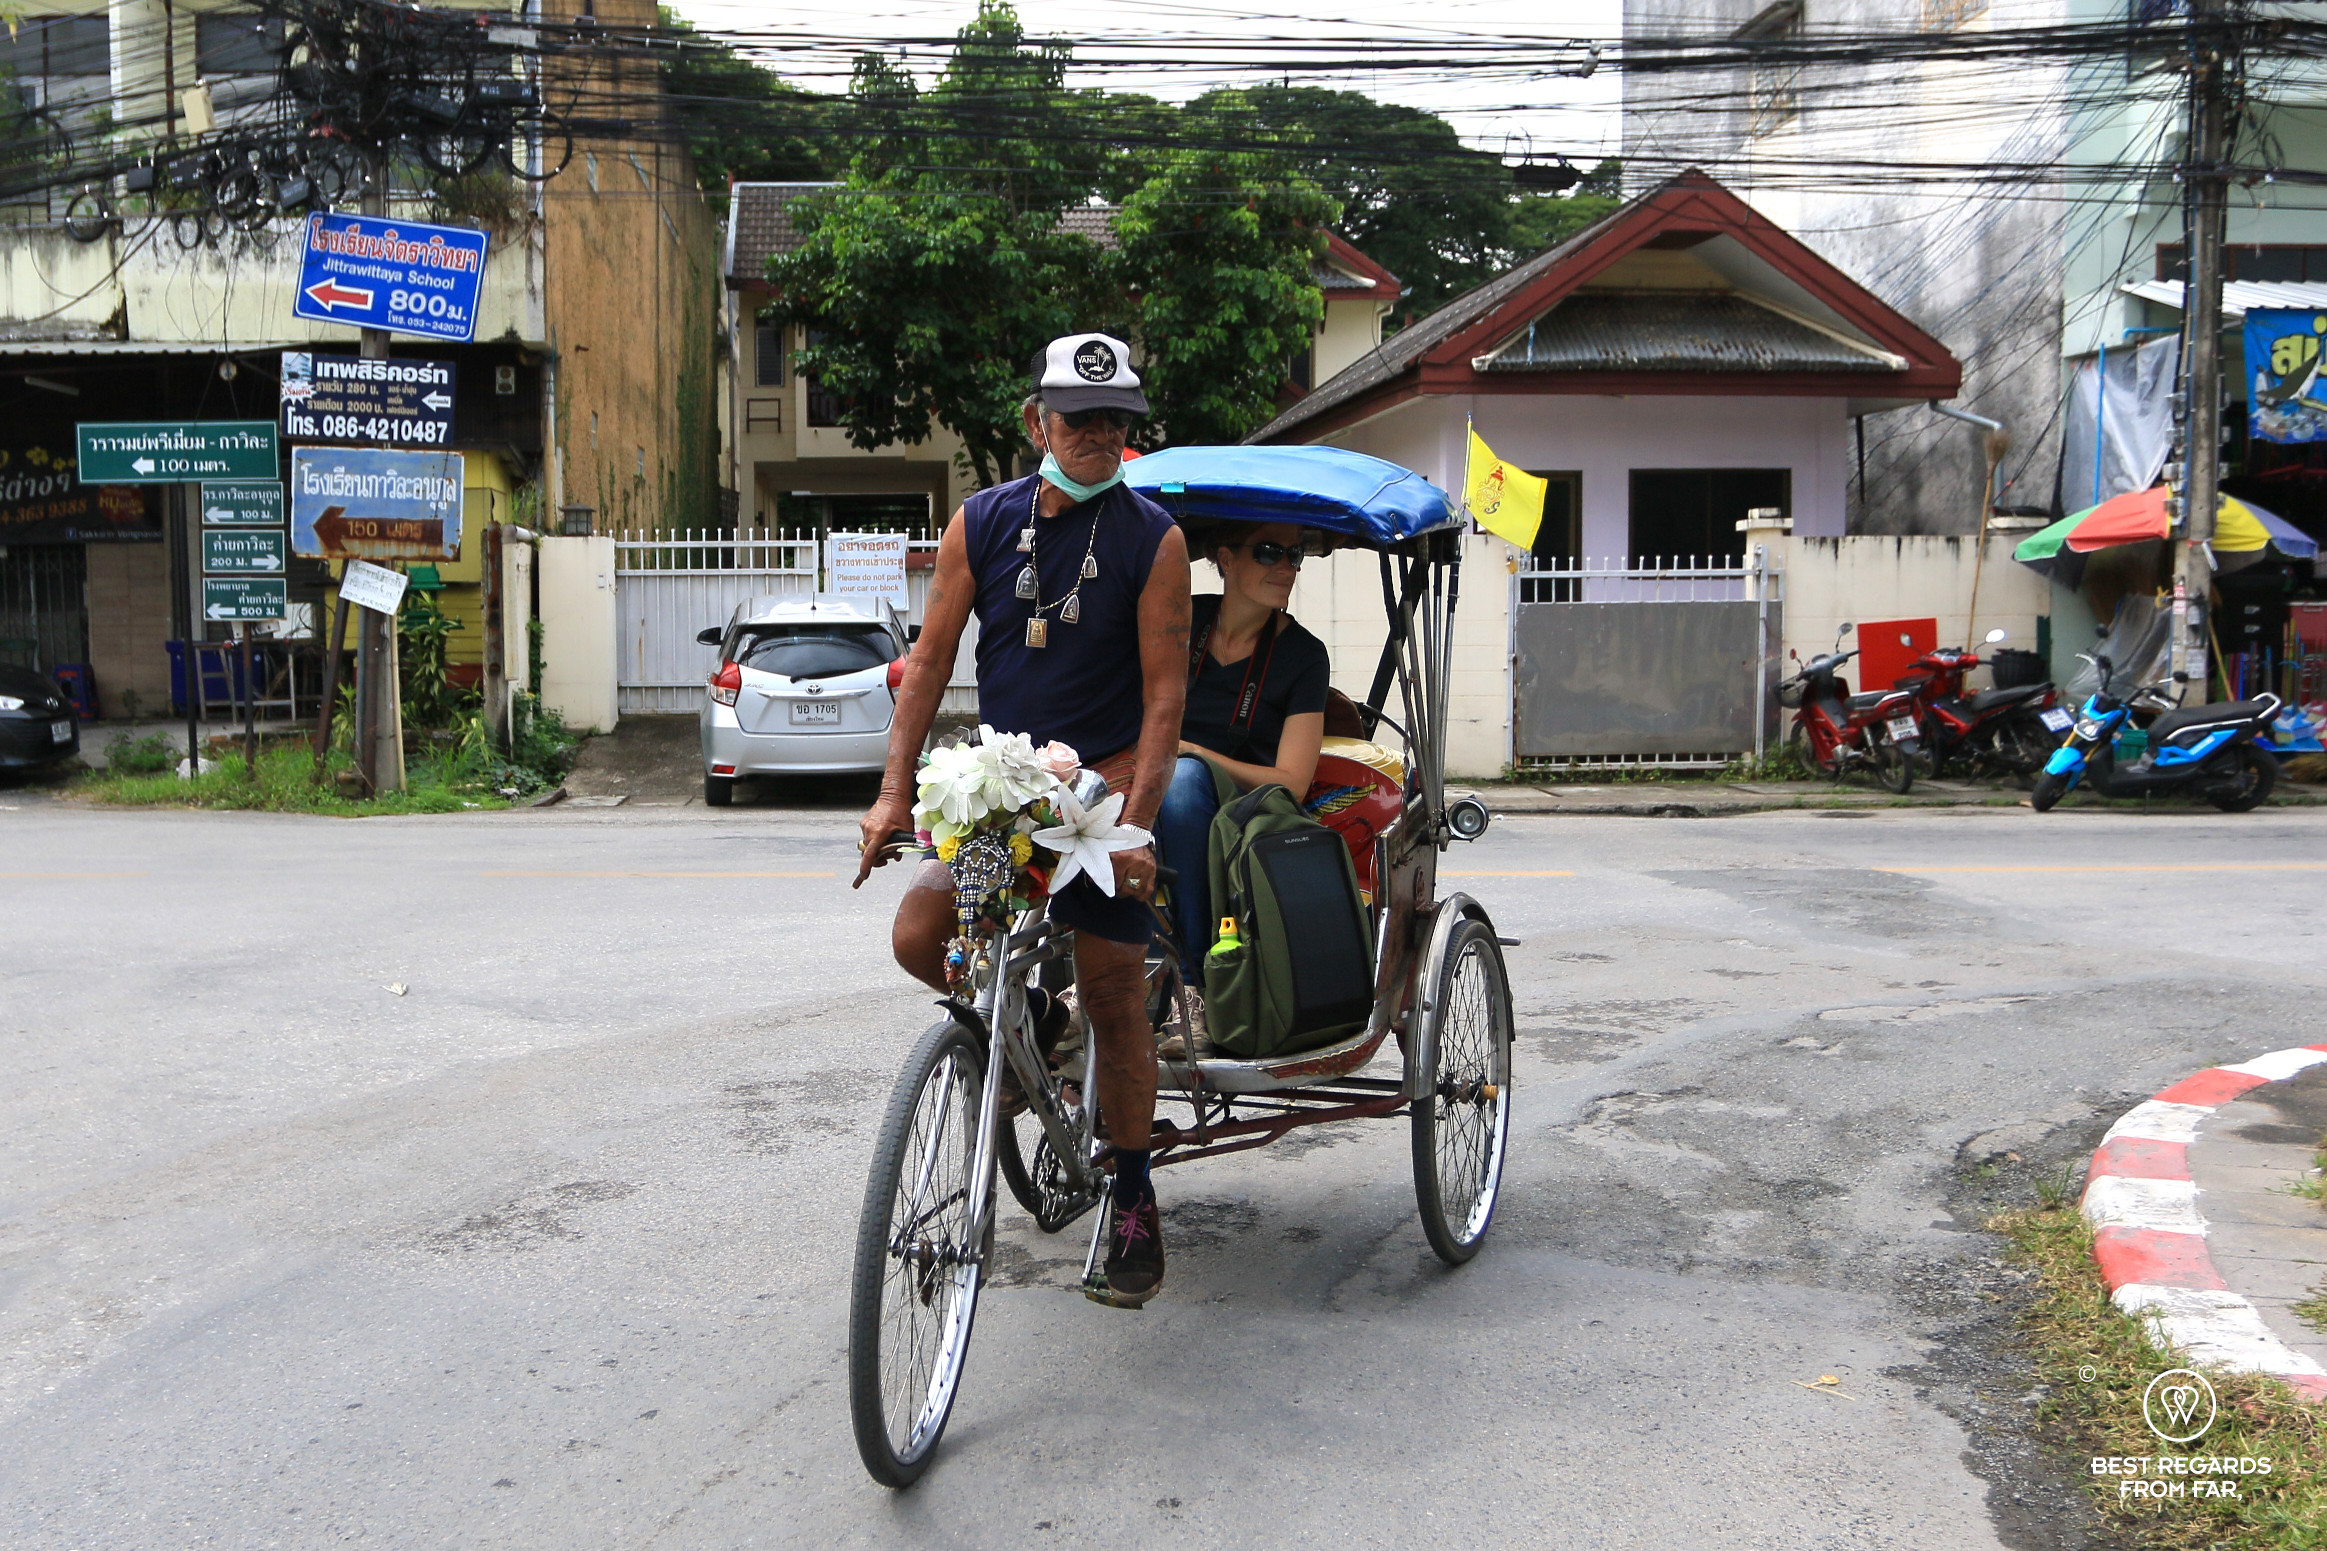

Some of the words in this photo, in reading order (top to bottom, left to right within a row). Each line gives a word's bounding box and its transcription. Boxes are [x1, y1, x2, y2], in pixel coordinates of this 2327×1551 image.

[310, 218, 478, 273] โรงเรียนจิตราวิทยา
[322, 257, 403, 284] Jittrawittaya
[407, 270, 455, 290] School
[1077, 355, 1097, 364] VANS
[316, 359, 449, 384] เทพสิริคอร์ท
[316, 380, 343, 393] รายวัน
[347, 383, 366, 394] 280
[307, 398, 343, 412] รายเดือน
[347, 401, 371, 414] 2000
[286, 406, 319, 436] โทร.
[322, 414, 448, 443] 086-4210487
[219, 431, 268, 450] กาวิละ
[160, 459, 190, 473] 100
[300, 463, 457, 511] โรงเรียนกาวิละอนุกูล
[241, 510, 258, 519] 100
[348, 520, 378, 537] 150
[213, 534, 274, 551] ค่ายกาวิละ
[838, 537, 899, 552] อย่าจอดรถ
[211, 557, 232, 566] 200
[836, 554, 904, 570] ขวางทางเข้าประตู
[837, 573, 861, 581] Please
[862, 573, 871, 581] do
[886, 573, 903, 582] park
[880, 584, 899, 592] block
[241, 606, 262, 616] 500
[1239, 682, 1256, 718] Canon
[815, 704, 837, 714] 1705
